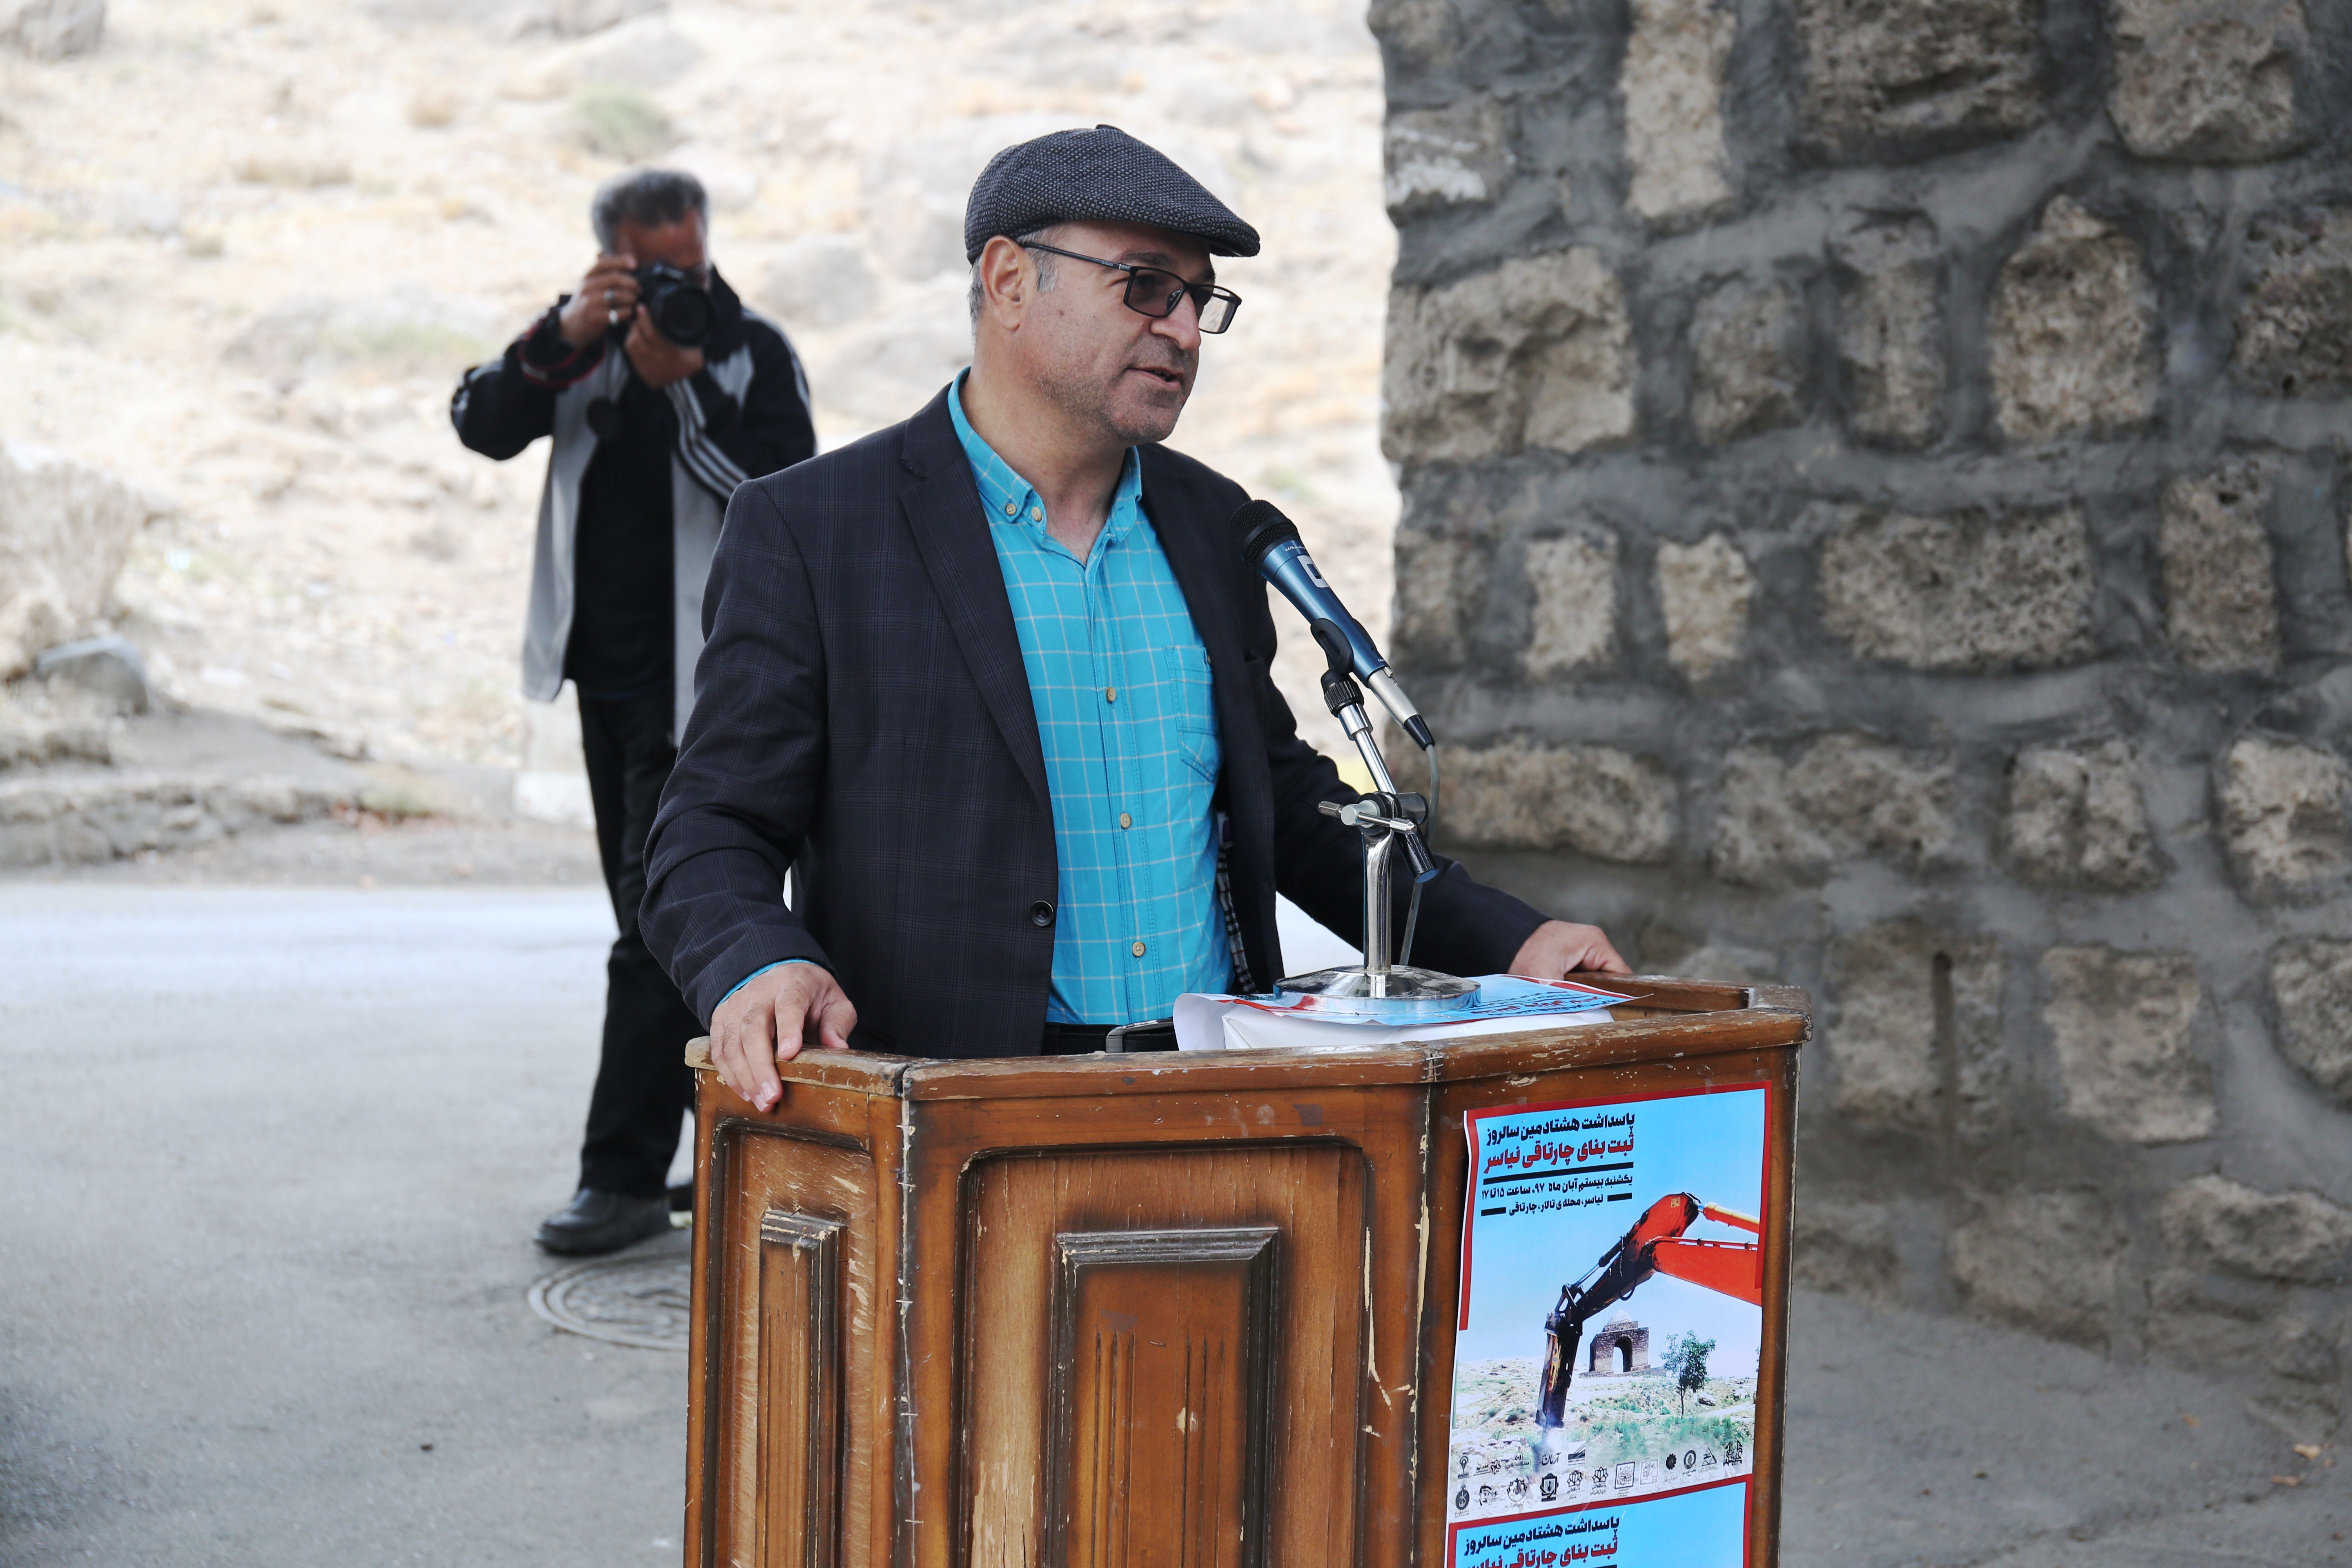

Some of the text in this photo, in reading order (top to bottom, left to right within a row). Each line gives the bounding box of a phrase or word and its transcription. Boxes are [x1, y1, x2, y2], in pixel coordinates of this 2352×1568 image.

[1486, 1112, 1635, 1146] پاسداشت هشتادمین سالروز
[1483, 1131, 1634, 1174] ثبت بنای چارتاقی نیاسر
[1548, 1182, 1561, 1192] ماه
[1562, 1178, 1578, 1193] آبان
[1579, 1178, 1604, 1192] بیستم
[1605, 1174, 1633, 1188] یکشنبه
[1482, 1189, 1489, 1200] ۱۷
[1490, 1188, 1496, 1198] تا
[1497, 1187, 1504, 1198] ۱۵
[1506, 1185, 1531, 1196] ساعت
[1509, 1201, 1537, 1216] چارتاقی
[1464, 1516, 1620, 1556] پاسداشت هشتادمین سالروز
[1591, 1534, 1618, 1559] ثبت
[1560, 1543, 1589, 1567] بنای
